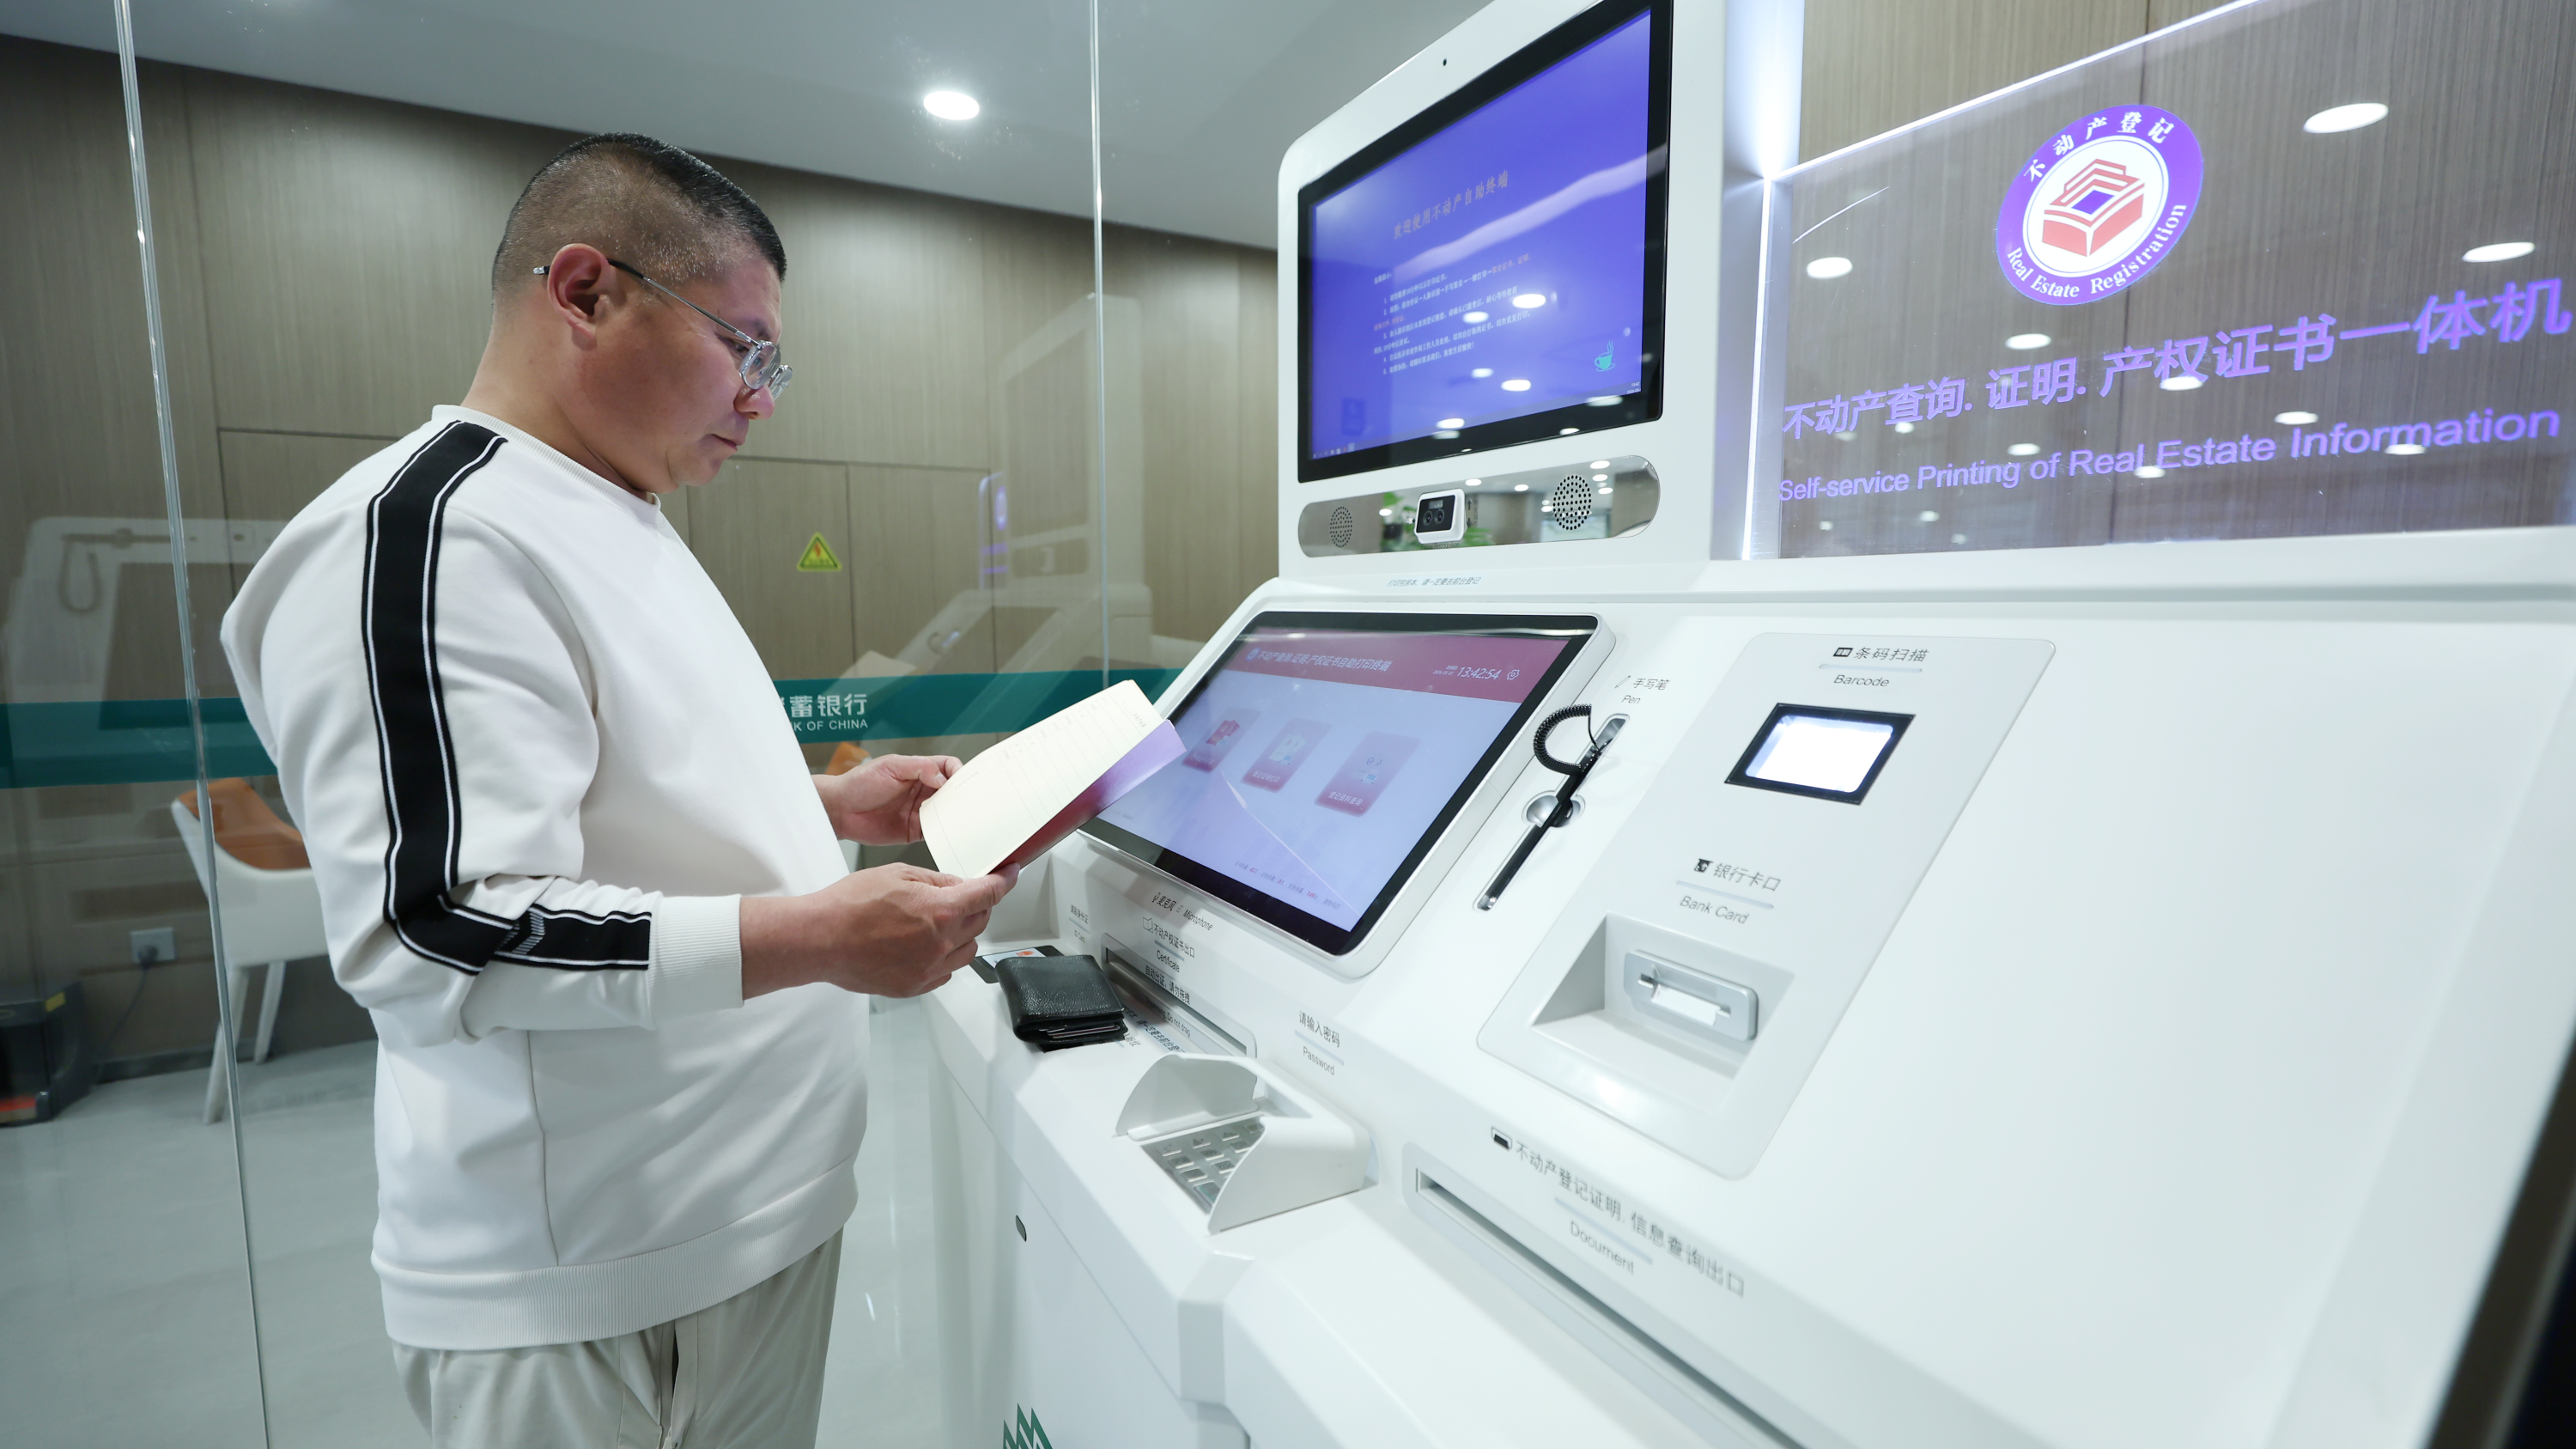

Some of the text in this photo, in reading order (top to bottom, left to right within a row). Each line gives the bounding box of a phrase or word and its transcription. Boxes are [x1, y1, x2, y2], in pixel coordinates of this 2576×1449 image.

[2023, 111, 2175, 183] 不动产登记
[1394, 169, 1509, 240] 欢迎使用不动产自助终端
[2007, 203, 2188, 298] Real Estate Registration
[1783, 277, 2573, 440] 不动产查询. 证明. 产权证书一体机
[1778, 408, 2561, 502] Self-service Printing of Real Estate Information
[1853, 647, 1930, 663] 条码扫描
[1457, 667, 1502, 679] 13:42:54
[1633, 678, 1671, 691] 手写笔
[1833, 674, 1890, 688] Barcode
[780, 693, 867, 718] 蓄银行
[1621, 694, 1641, 703] Pen
[807, 721, 824, 731] OF
[829, 719, 868, 730] CHINA
[1327, 791, 1364, 807] 登记资料查询
[1713, 861, 1782, 892] 银行卡口
[1157, 895, 1177, 911] 麦克风
[1680, 894, 1750, 925] Bank Card
[1183, 909, 1213, 931] Microphone
[1153, 923, 1195, 959] 不动产权证书出口
[1157, 949, 1180, 972] Certificate
[1173, 1018, 1182, 1029] not
[1299, 1010, 1340, 1048] 请输入密码
[1303, 1045, 1334, 1075] Password
[1570, 1220, 1635, 1276] Document
[1631, 1212, 1746, 1299] 信息查询出口
